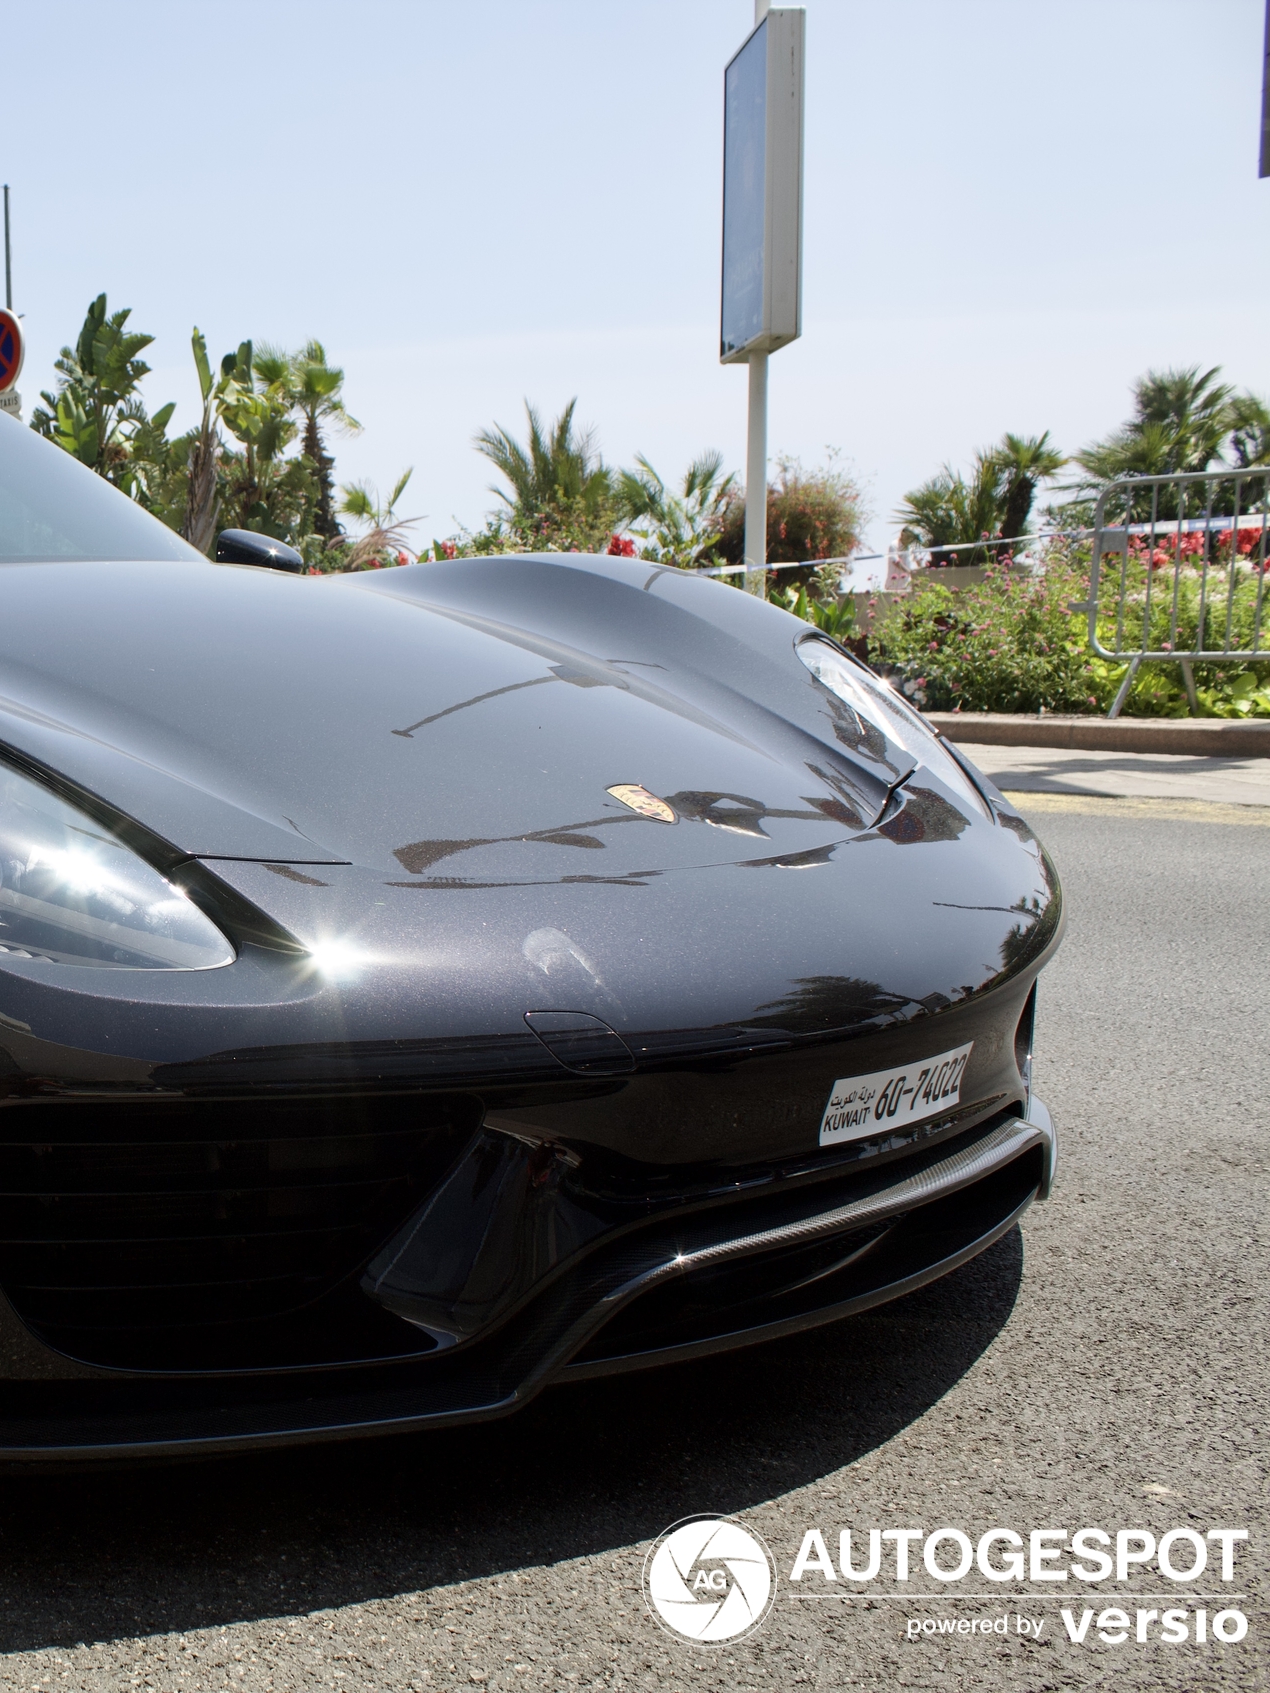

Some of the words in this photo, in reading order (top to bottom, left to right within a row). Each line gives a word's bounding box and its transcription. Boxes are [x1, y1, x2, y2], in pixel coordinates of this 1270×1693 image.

[0, 395, 19, 409] TAXIS
[858, 1086, 876, 1102] دولة
[874, 1053, 968, 1121] 60-74022
[830, 1090, 857, 1111] الكويت
[823, 1107, 871, 1132] KUWAIT
